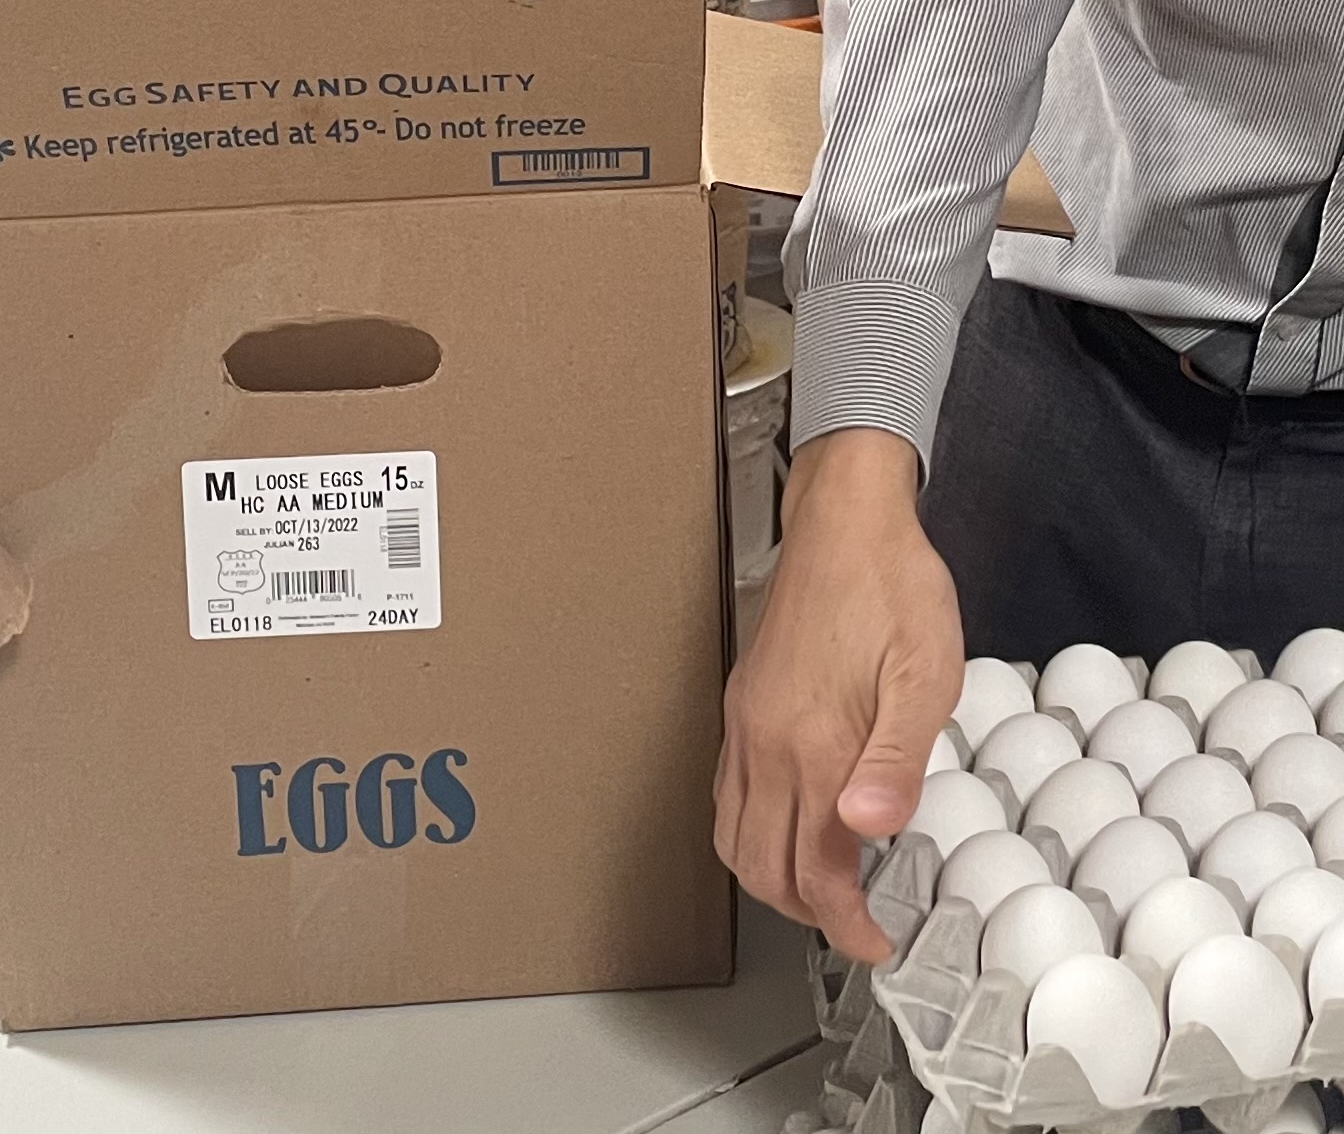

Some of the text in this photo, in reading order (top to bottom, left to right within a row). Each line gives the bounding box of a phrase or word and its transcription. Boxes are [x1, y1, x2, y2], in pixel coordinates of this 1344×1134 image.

[62, 85, 136, 109] EGG
[144, 79, 281, 105] SAFETY
[378, 73, 536, 99] QUALITY
[24, 133, 98, 162] Keep
[107, 121, 280, 158] refrigerated
[289, 122, 316, 145] at
[395, 117, 432, 141] Do
[441, 116, 488, 139] not
[495, 114, 586, 138] freeze
[205, 466, 425, 502] M LOOSE EGGS 15 DZ
[240, 491, 384, 514] HC AA MEDIUM
[235, 528, 258, 536] SELL
[275, 517, 359, 536] OCT/13/2022
[264, 536, 320, 552] JULIAN 263
[210, 616, 273, 633] EL0118
[367, 608, 419, 626] 24DAY
[231, 748, 476, 856] EGGS
